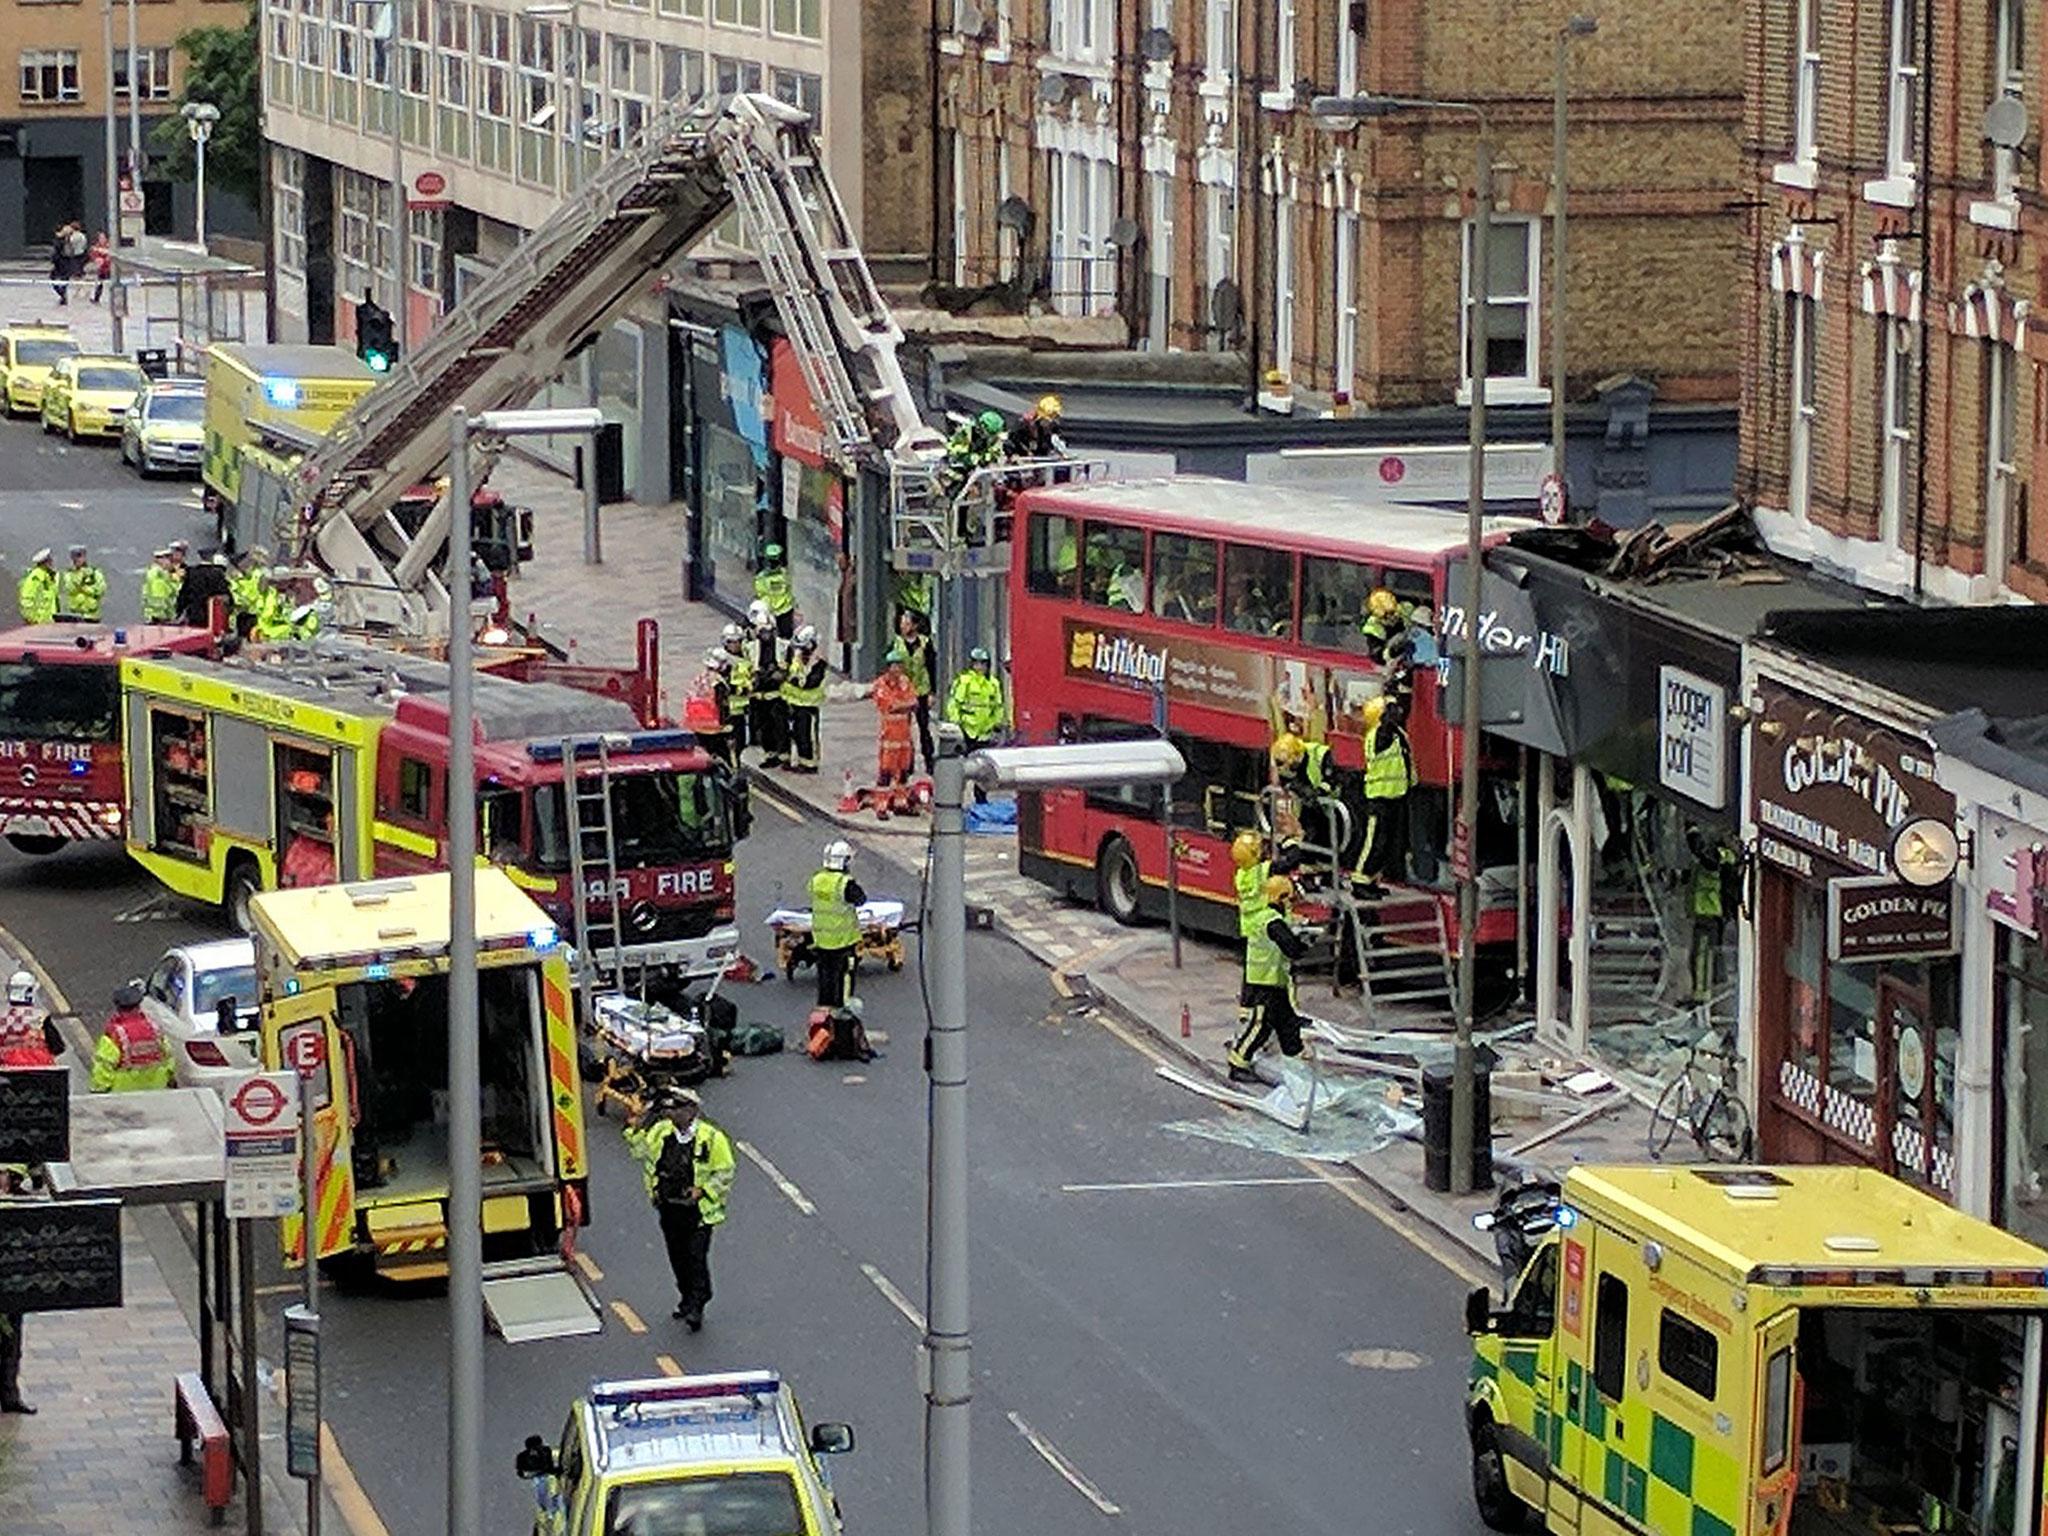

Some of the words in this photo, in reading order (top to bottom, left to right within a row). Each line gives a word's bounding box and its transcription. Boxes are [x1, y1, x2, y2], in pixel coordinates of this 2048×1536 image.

[40, 741, 92, 763] FIRE
[656, 868, 714, 897] FIRE
[1843, 895, 1918, 924] GOLDEN
[1920, 899, 1947, 921] PIE
[298, 1037, 316, 1065] E
